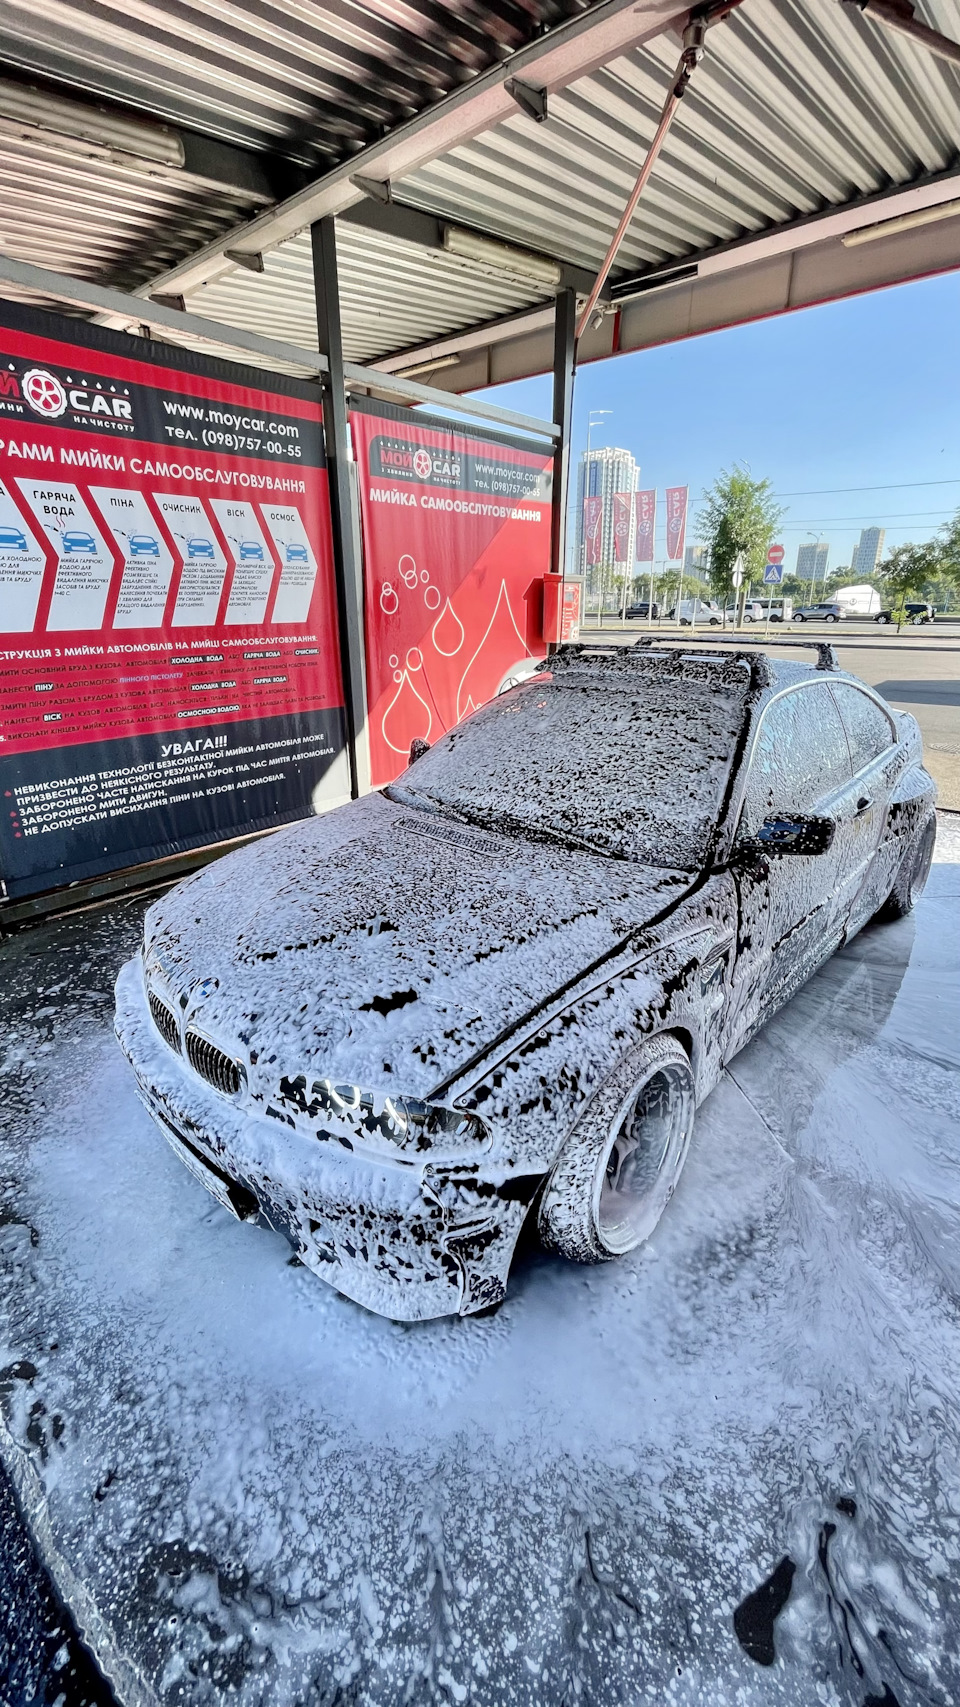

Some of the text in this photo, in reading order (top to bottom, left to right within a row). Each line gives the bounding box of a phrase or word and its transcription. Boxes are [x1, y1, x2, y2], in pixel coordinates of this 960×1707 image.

[69, 390, 133, 420] CAR
[73, 415, 88, 425] НА
[89, 418, 135, 433] ЧИСТОТУ
[162, 401, 299, 438] www.moycar.com
[165, 426, 302, 458] тел. (098)757-00-55
[380, 449, 413, 468] МОЙ
[60, 448, 126, 471] МИЙКИ
[130, 458, 306, 493] САМООБСЛУГОВУВАННЯ
[432, 460, 461, 477] CAR
[474, 463, 540, 483] www.moycar.com
[33, 490, 76, 503] ГАРЯЧА
[474, 479, 540, 497] тел. (098)757-00-55
[43, 505, 75, 516] ВОДА
[110, 498, 134, 508] ПІНА
[162, 503, 201, 514] ОЧИСНИК
[370, 487, 541, 522] МИЙКА САМООБСЛУГОВУВАННЯ
[227, 509, 245, 518] ВІСК
[270, 513, 295, 522] ОСМОС
[64, 645, 104, 656] МИЙКИ
[107, 642, 173, 654] АВТОМОБІЛІВ
[175, 641, 189, 650] НА
[190, 639, 220, 648] МИЙЦІ
[22, 665, 66, 674] ОСНОВНИЙ
[171, 656, 203, 664] ХОЛОДНА
[35, 683, 54, 691] ПІНУ
[66, 678, 118, 688] ДОПОМОГОЮ
[119, 675, 149, 683] ПІННОГО
[150, 672, 183, 680] ПІСТОЛЕТУ
[83, 694, 113, 702] БРУДОМ
[43, 713, 62, 721] ВІСК
[177, 707, 217, 718] ОСМОСНОЮ
[161, 735, 227, 757] УВАГА!!!
[14, 733, 324, 795] НЕВИКОНАННЯ ТЕХНОЛОГІЇ БЕЗКОНТАКТНОЇ МИЙКИ АВТОМОБІЛЯ МОЖЕ
[16, 762, 216, 806] ПРИЗВЕСТИ ДО НЕЯКІСНОГО РЕЗУЛЬТАТУ.
[19, 747, 336, 816] ЗАБОРОНЕНО ЧАСТЕ НАТИСКАННЯ НА КУРОК ПІД ЧАС МИТТЯ АВТОМОБІЛЯ.
[21, 789, 168, 826] ЗАБОРОНЕНО МИТИ ДВИГУН.
[24, 773, 286, 836] НЕ ДОПУСКАТИ ВИСИХАННЯ ПІНИ НА КУЗОВІ АВТОМОБІЛЯ.
